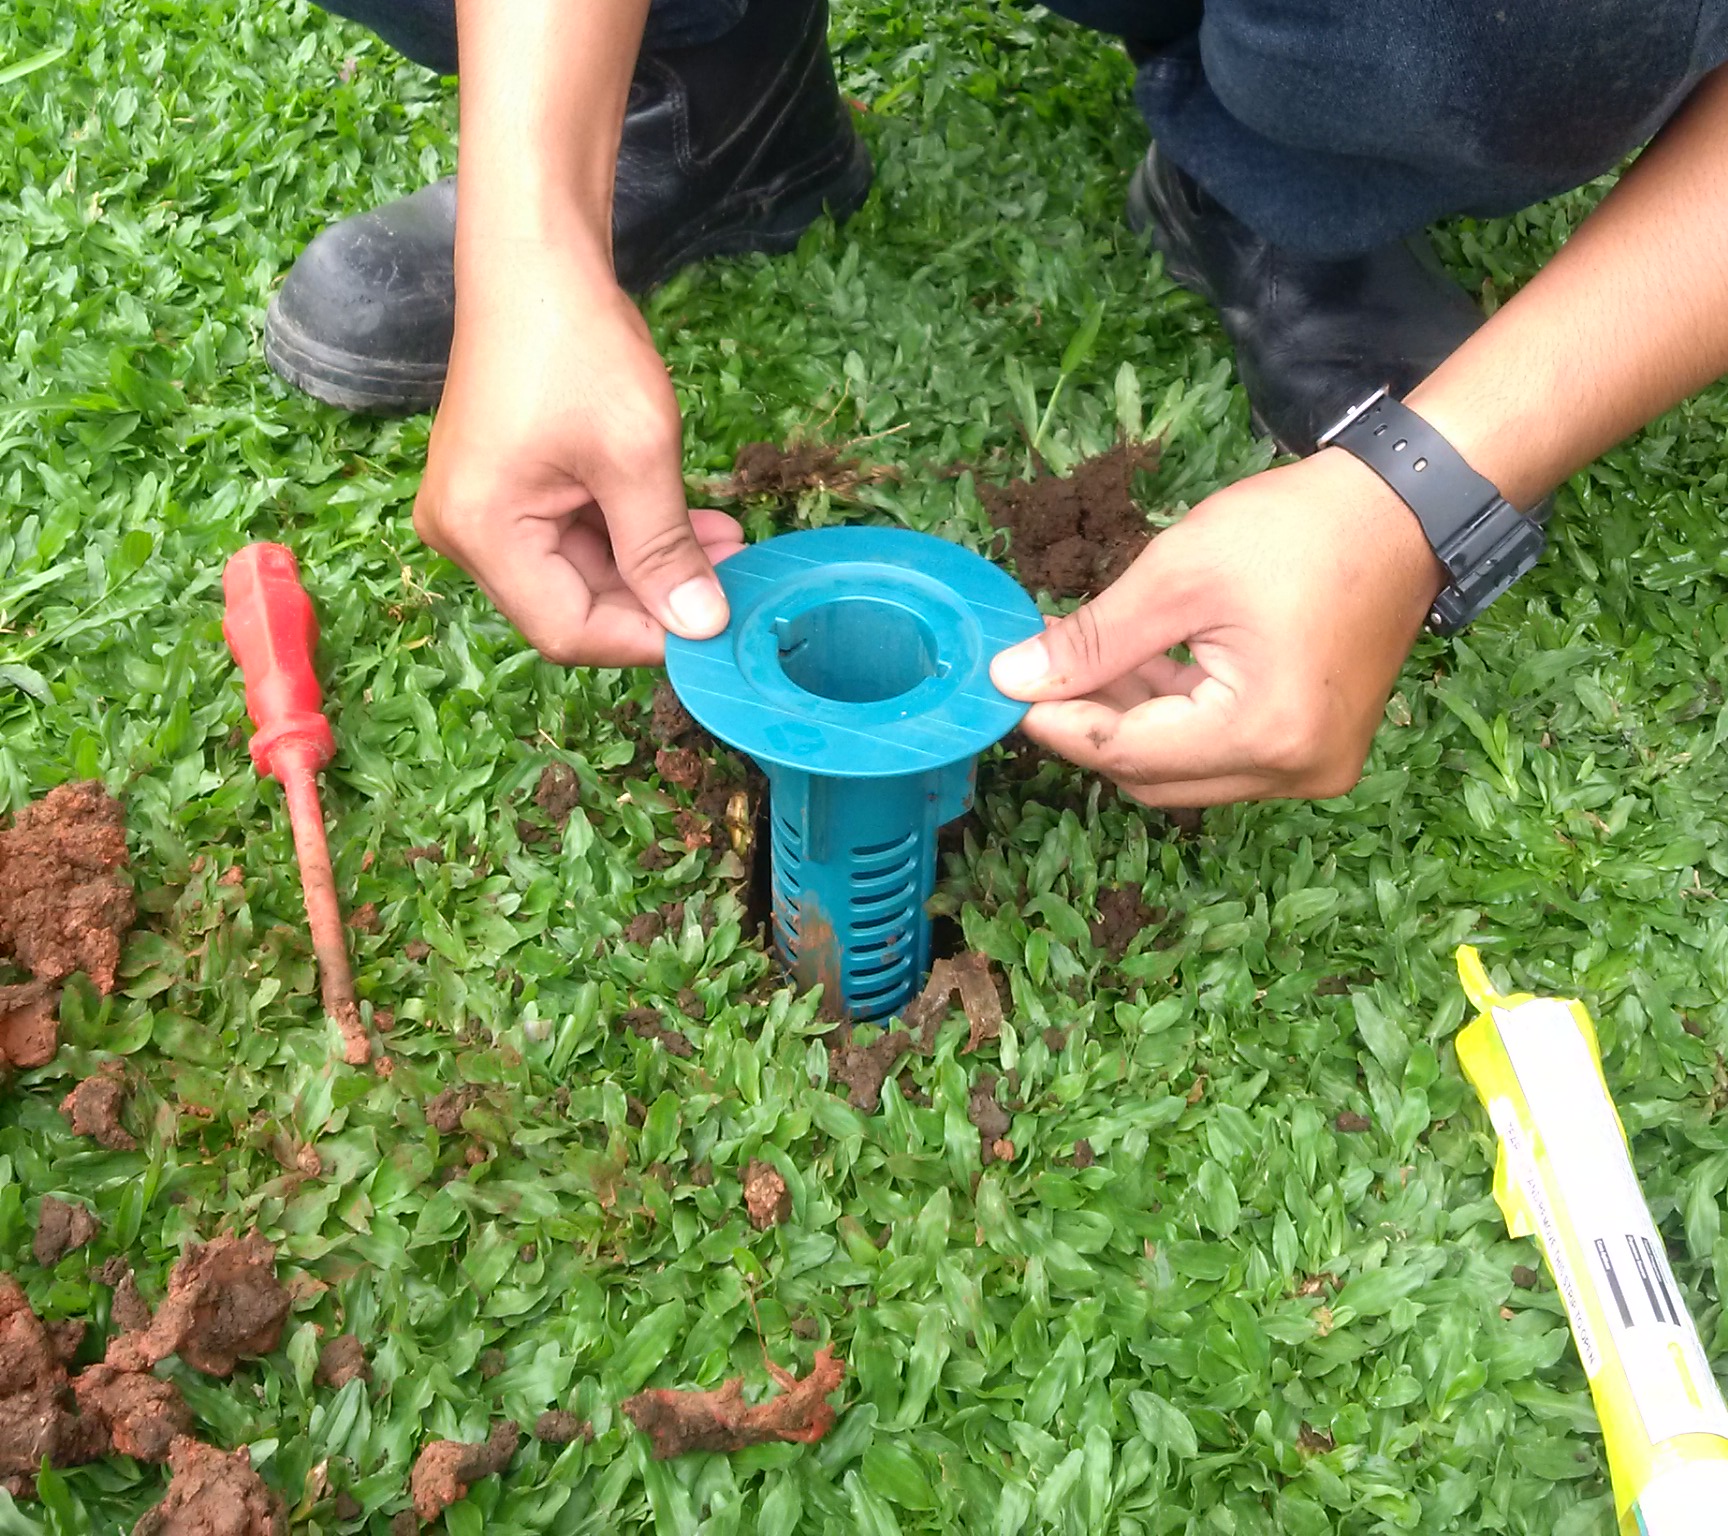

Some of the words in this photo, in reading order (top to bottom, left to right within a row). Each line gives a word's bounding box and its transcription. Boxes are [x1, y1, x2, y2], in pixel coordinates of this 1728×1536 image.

[1562, 1275, 1577, 1309] STRIP
[1575, 1310, 1584, 1330] TO
[1580, 1328, 1596, 1365] OPEN
